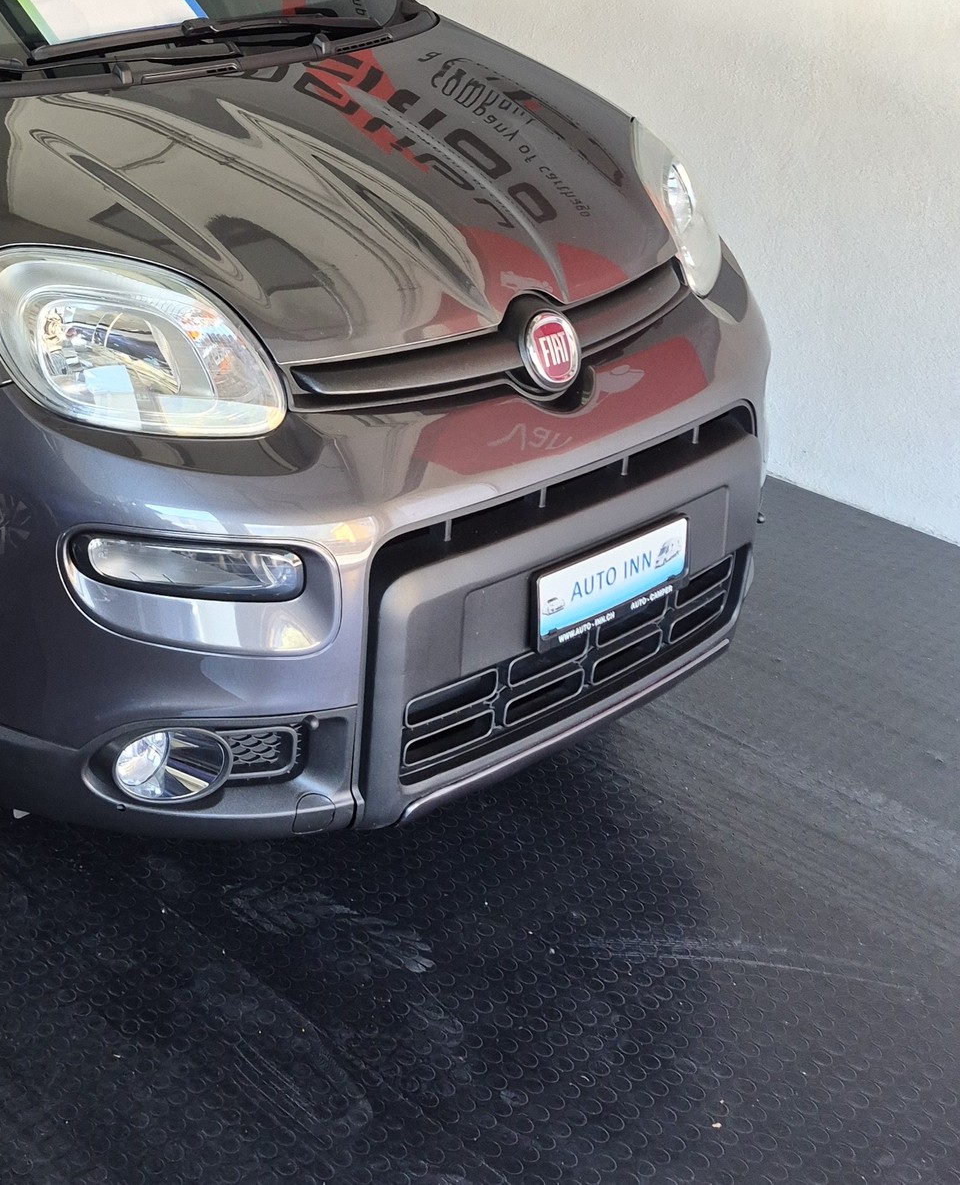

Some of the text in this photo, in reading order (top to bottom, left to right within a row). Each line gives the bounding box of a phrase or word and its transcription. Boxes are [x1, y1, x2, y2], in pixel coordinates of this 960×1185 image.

[539, 332, 569, 367] FIAT
[570, 550, 652, 602] AUTO INN
